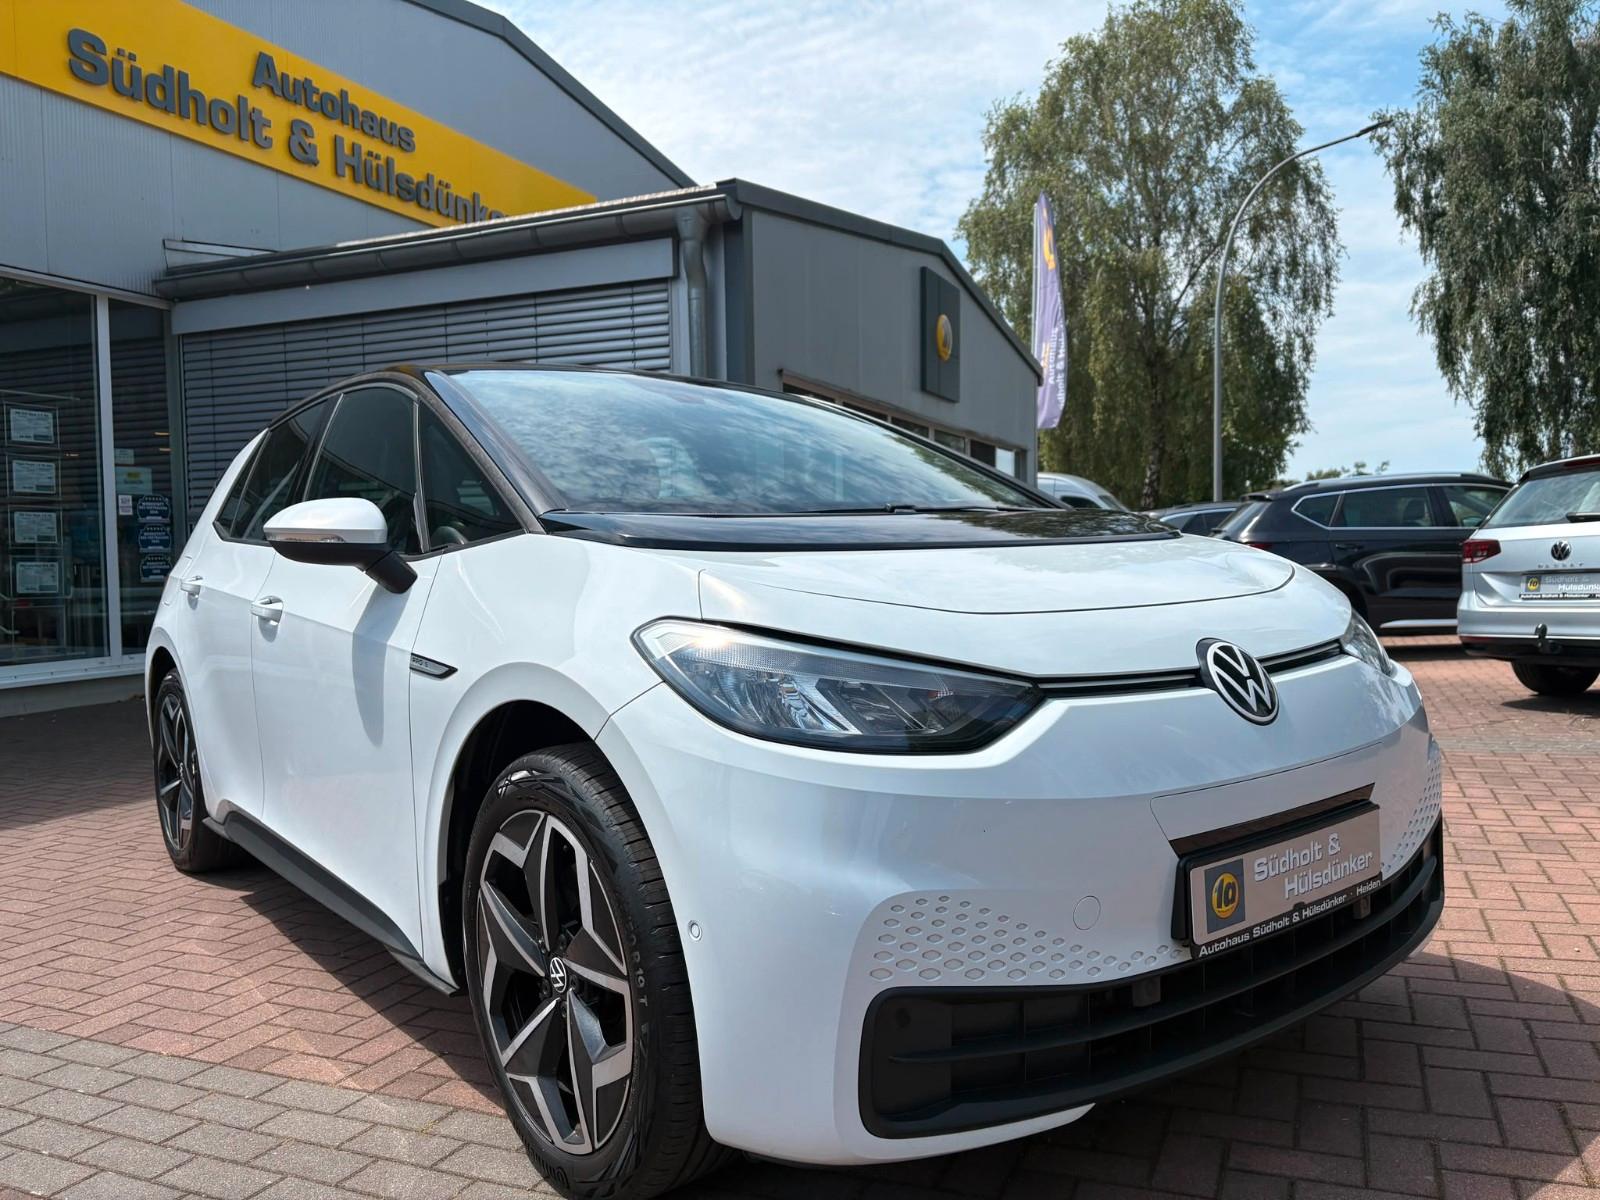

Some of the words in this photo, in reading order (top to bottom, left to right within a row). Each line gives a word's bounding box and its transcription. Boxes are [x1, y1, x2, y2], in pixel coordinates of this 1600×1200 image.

[67, 28, 273, 150] Südholt
[288, 119, 320, 166] &
[252, 51, 416, 153] Autohaus
[1253, 840, 1323, 882] Südholt
[1328, 832, 1341, 856] &
[1284, 850, 1374, 899] Hülsdünker
[1198, 931, 1250, 958] Autohaus
[1252, 916, 1290, 938] Südholt
[1292, 912, 1301, 923] &
[1302, 893, 1347, 919] Hülsdünker
[1356, 879, 1382, 897] Heiden
